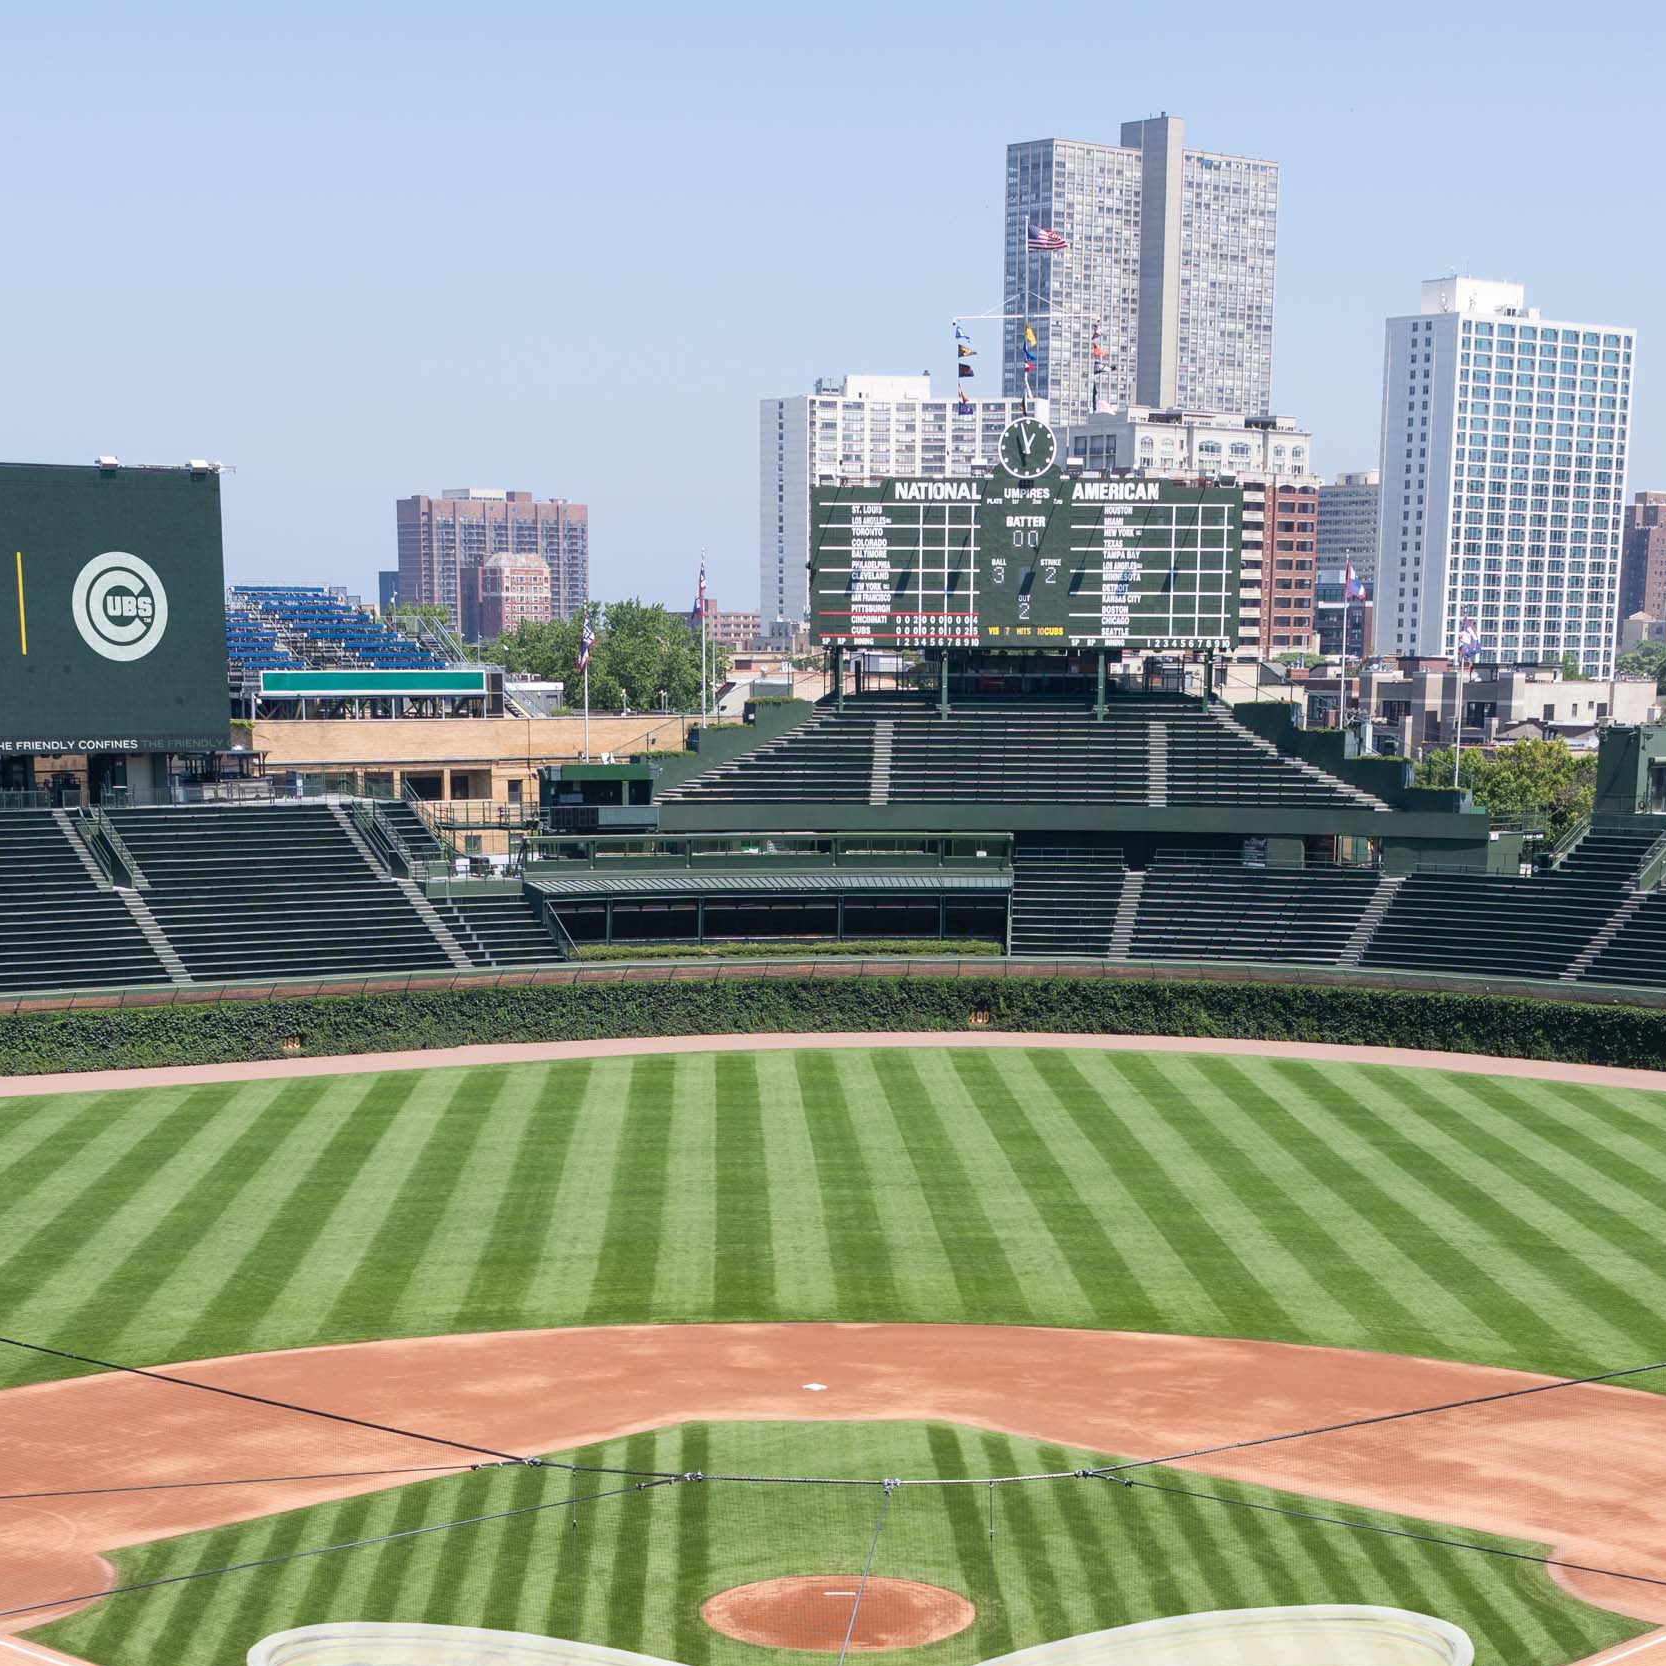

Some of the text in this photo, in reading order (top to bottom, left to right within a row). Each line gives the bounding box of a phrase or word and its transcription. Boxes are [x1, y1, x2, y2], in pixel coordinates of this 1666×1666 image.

[895, 482, 981, 499] NATIONAL
[1004, 488, 1050, 498] UMPIRES
[1072, 483, 1159, 500] AMERICAN
[852, 505, 883, 514] ST. LOUIS
[1104, 506, 1133, 515] HOUSTON
[852, 517, 862, 525] LOS
[863, 517, 886, 525] ANGELES
[1006, 516, 1046, 527] BATTER
[1104, 518, 1123, 526] MIAMI
[852, 528, 883, 536] TORONTO
[1104, 529, 1115, 537] NEW
[1117, 529, 1134, 537] YORK
[852, 539, 887, 547] COLORADO
[1104, 539, 1123, 548] TEXAS
[852, 550, 887, 558] BALTIMORE
[1103, 551, 1140, 559] TAMPA BAY
[852, 561, 890, 569] PHILADELPHIA
[1102, 562, 1113, 570] LOS
[1113, 562, 1137, 570] ANGELES
[852, 572, 889, 580] CLEVELAND
[993, 567, 1005, 584] 3
[1045, 567, 1056, 584] 2
[1102, 573, 1141, 581] MINNESOTA
[1102, 584, 1129, 592] DETROIT
[852, 594, 891, 602] SAN FRANCISCO
[1102, 595, 1141, 603] KANSAS CITY
[851, 604, 890, 613] PITTSBURGH
[1019, 603, 1030, 620] 2
[1102, 606, 1128, 614] BOSTON
[851, 615, 887, 624] CINCINNATI
[896, 616, 978, 624] 0 0 2 0 0 0 0 0 0 4
[1101, 617, 1129, 625] CHICAGO
[851, 626, 870, 634] CUBS
[896, 626, 901, 635] 0
[905, 626, 909, 635] 0
[913, 626, 918, 635] 0
[922, 626, 926, 635] 0
[930, 626, 935, 635] 2
[939, 626, 943, 635] 0
[956, 626, 960, 635] 0
[965, 626, 969, 635] 2
[973, 626, 978, 635] 5
[988, 627, 1064, 635] VIS HITS CUBS
[1101, 628, 1129, 636] SEATTLE
[904, 638, 910, 646] 2
[914, 638, 919, 646] 3
[921, 638, 926, 646] 4
[930, 638, 934, 646] 5
[938, 638, 944, 646] 6
[947, 638, 952, 646] 7
[955, 638, 961, 646] 8
[964, 638, 969, 646] 9
[971, 638, 979, 646] 10
[1155, 639, 1160, 647] 2
[1164, 639, 1169, 647] 3
[1172, 639, 1177, 647] 4
[1180, 639, 1186, 647] 5
[1189, 639, 1194, 647] 6
[1198, 639, 1203, 647] 7
[1206, 639, 1211, 647] 8
[1214, 639, 1219, 647] 9
[1222, 639, 1230, 647] 10
[16, 741, 75, 750] FRIENDLY
[78, 739, 138, 750] CONFINES
[969, 1011, 989, 1023] 400
